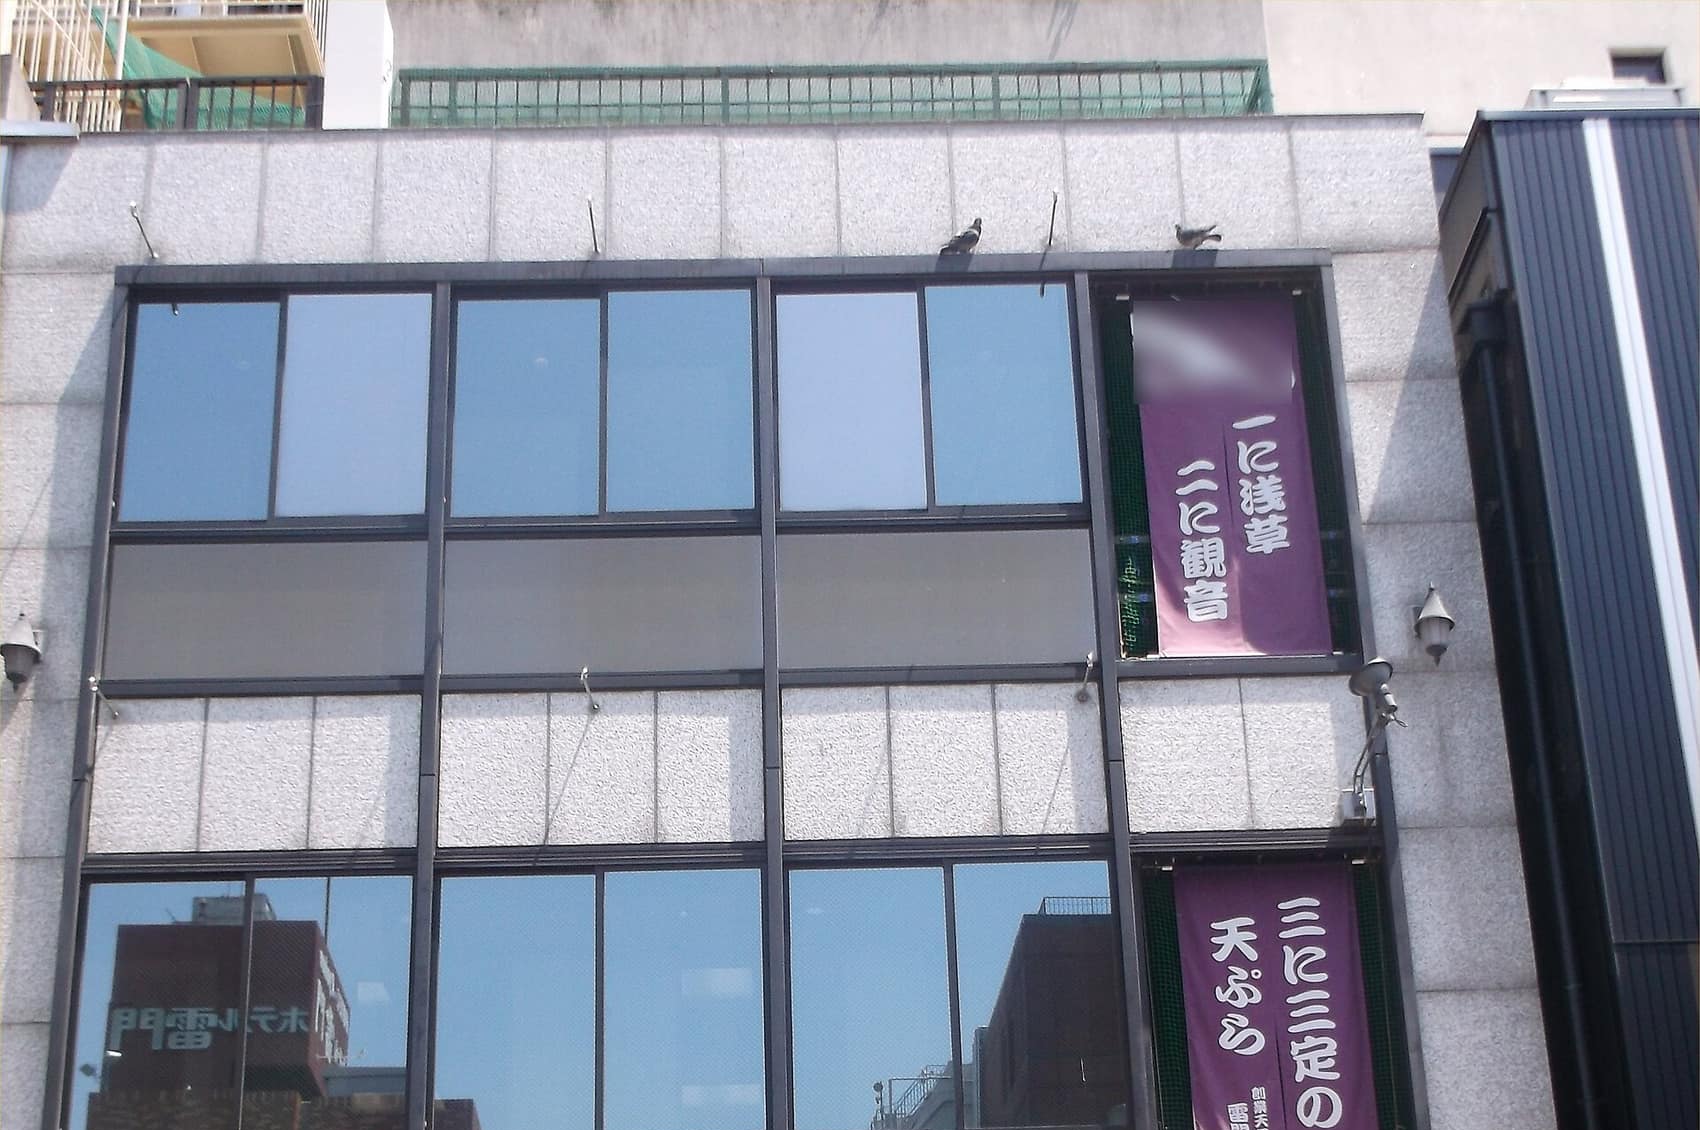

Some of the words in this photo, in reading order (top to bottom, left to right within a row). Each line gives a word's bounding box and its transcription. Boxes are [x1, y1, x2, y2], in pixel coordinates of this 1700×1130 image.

[1175, 459, 1229, 623] 二に観音
[1231, 414, 1291, 555] 一に浅草
[1209, 916, 1267, 1057] 天ぷら
[1277, 896, 1343, 1130] 三に三定の
